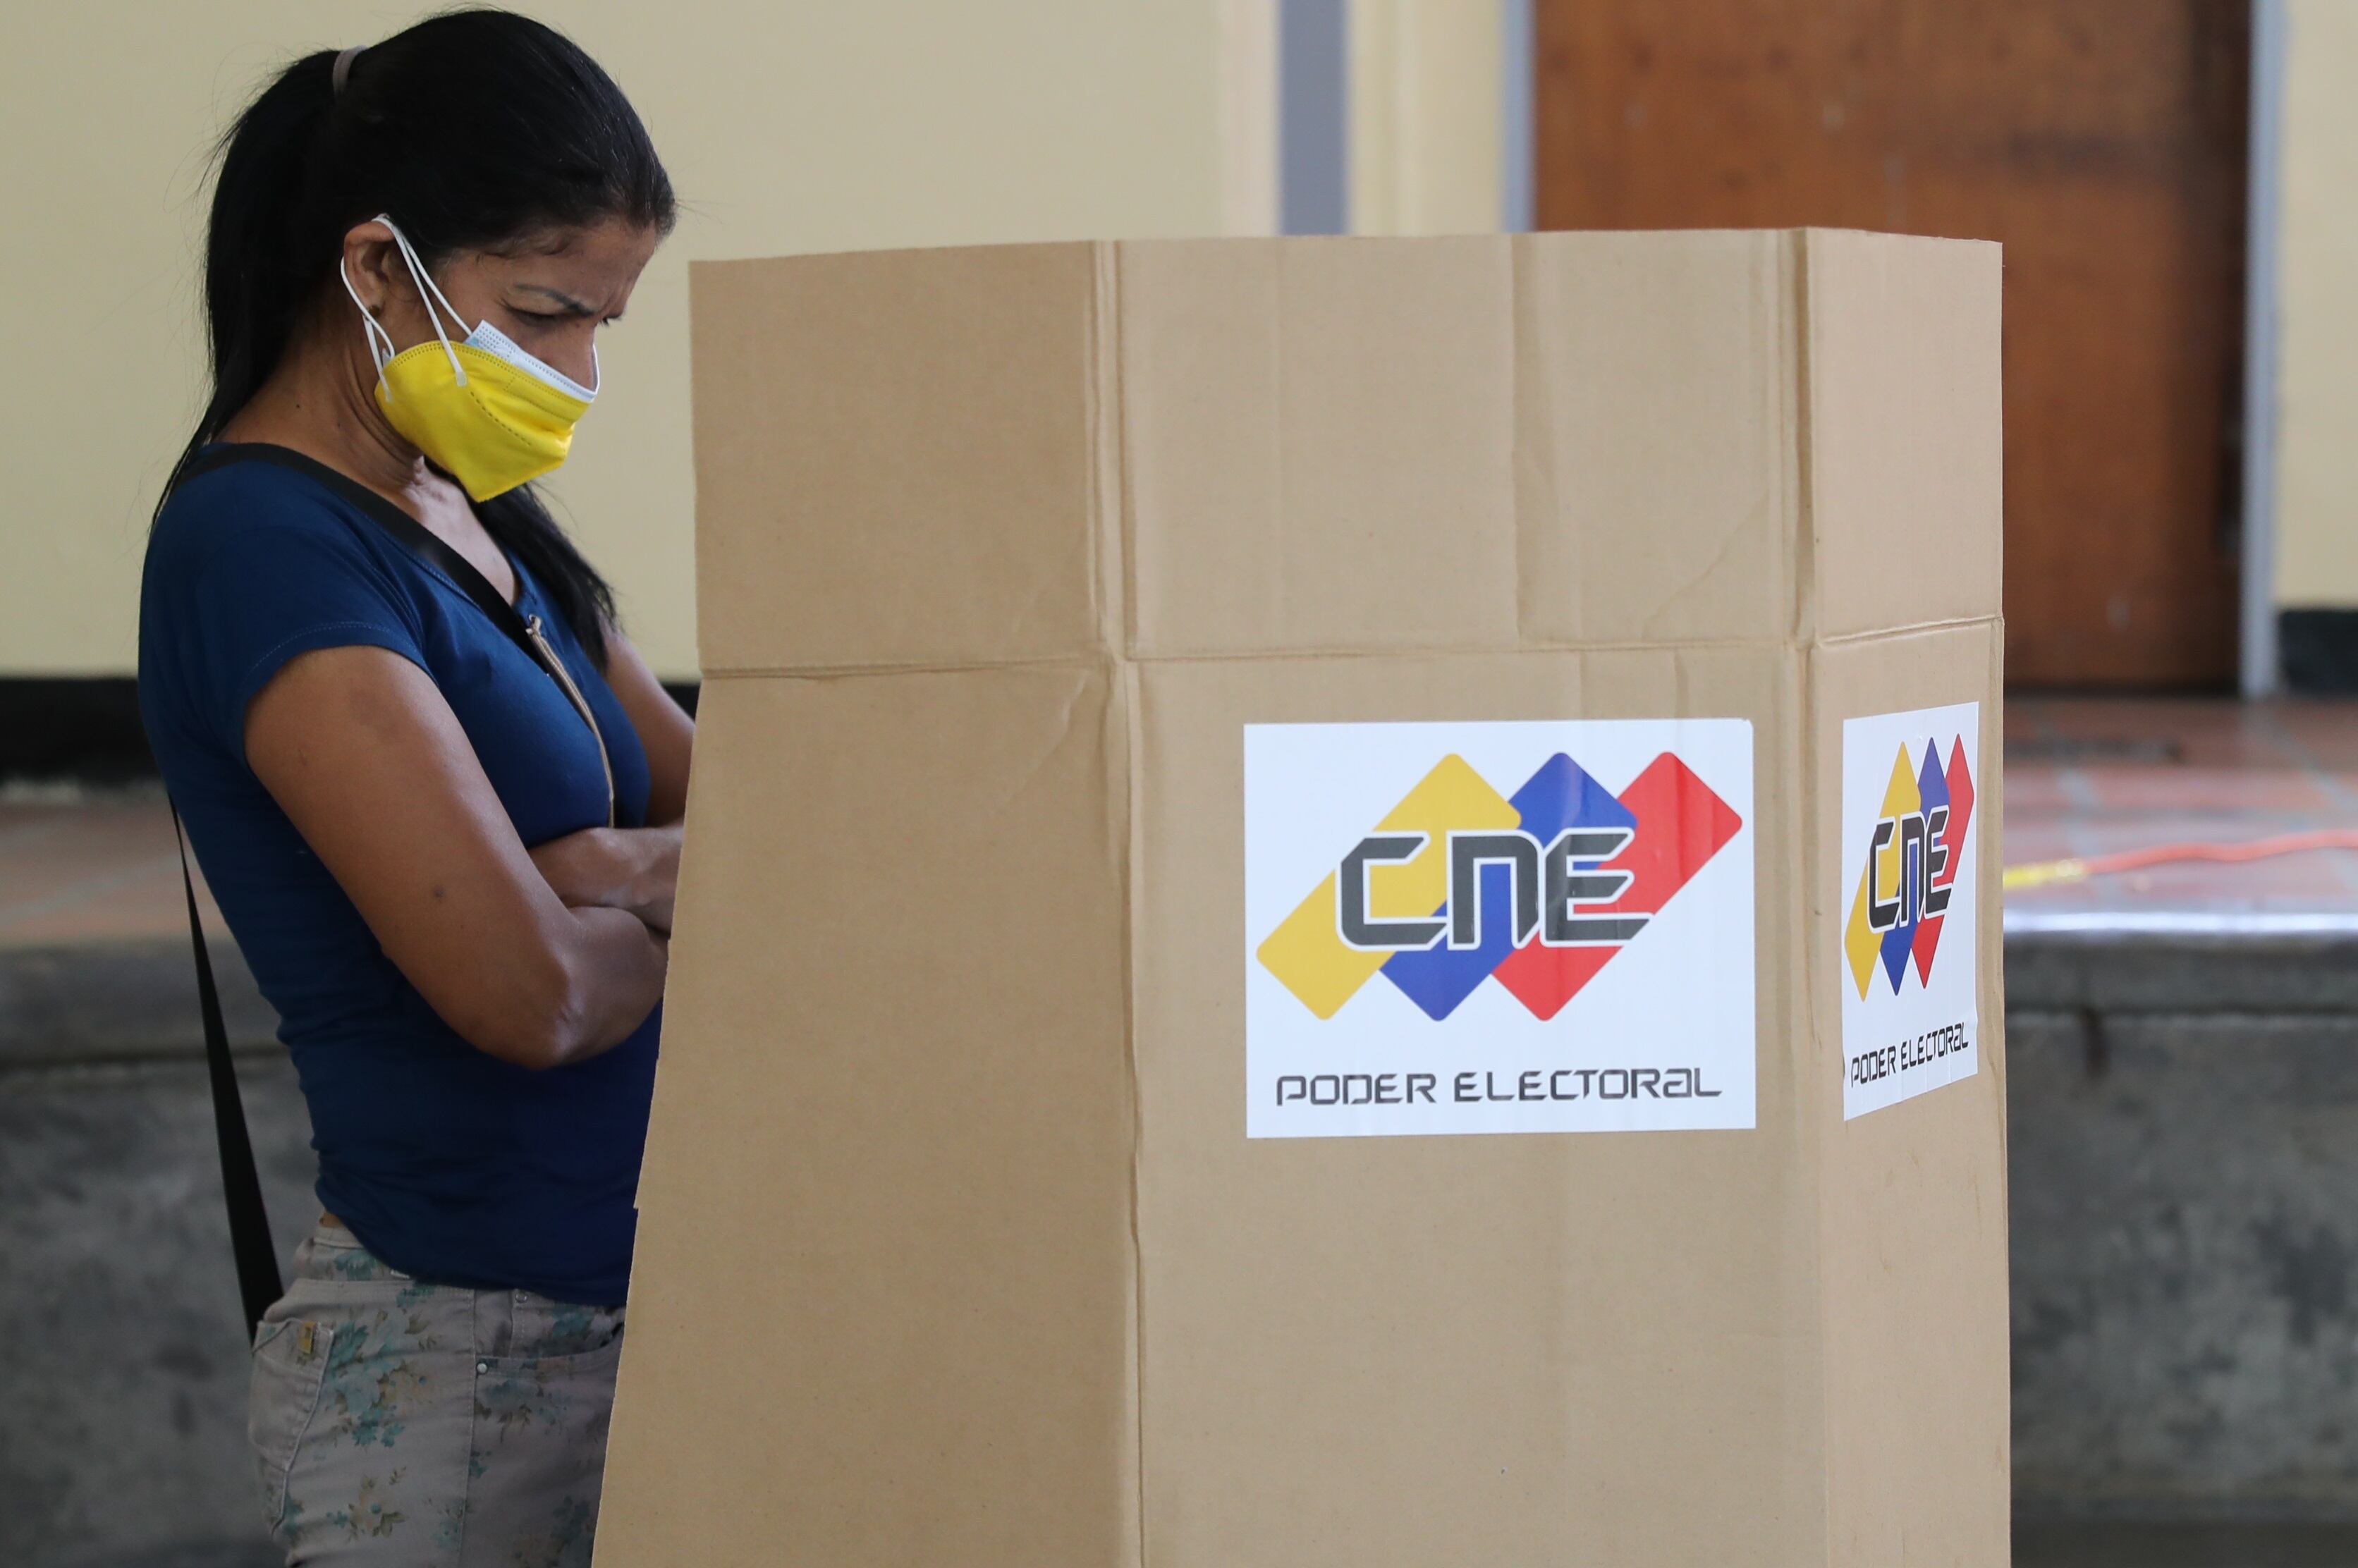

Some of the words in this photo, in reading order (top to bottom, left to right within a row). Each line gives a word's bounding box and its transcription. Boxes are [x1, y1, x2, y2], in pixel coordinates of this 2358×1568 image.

[1340, 833, 1649, 945] CNE
[1869, 809, 1952, 929] CNE
[1276, 1073, 1437, 1106] PODER
[1453, 1067, 1722, 1103] ELECTORAL
[1851, 1046, 1896, 1088] PODER
[1900, 1022, 1969, 1071] ELECTORAL
